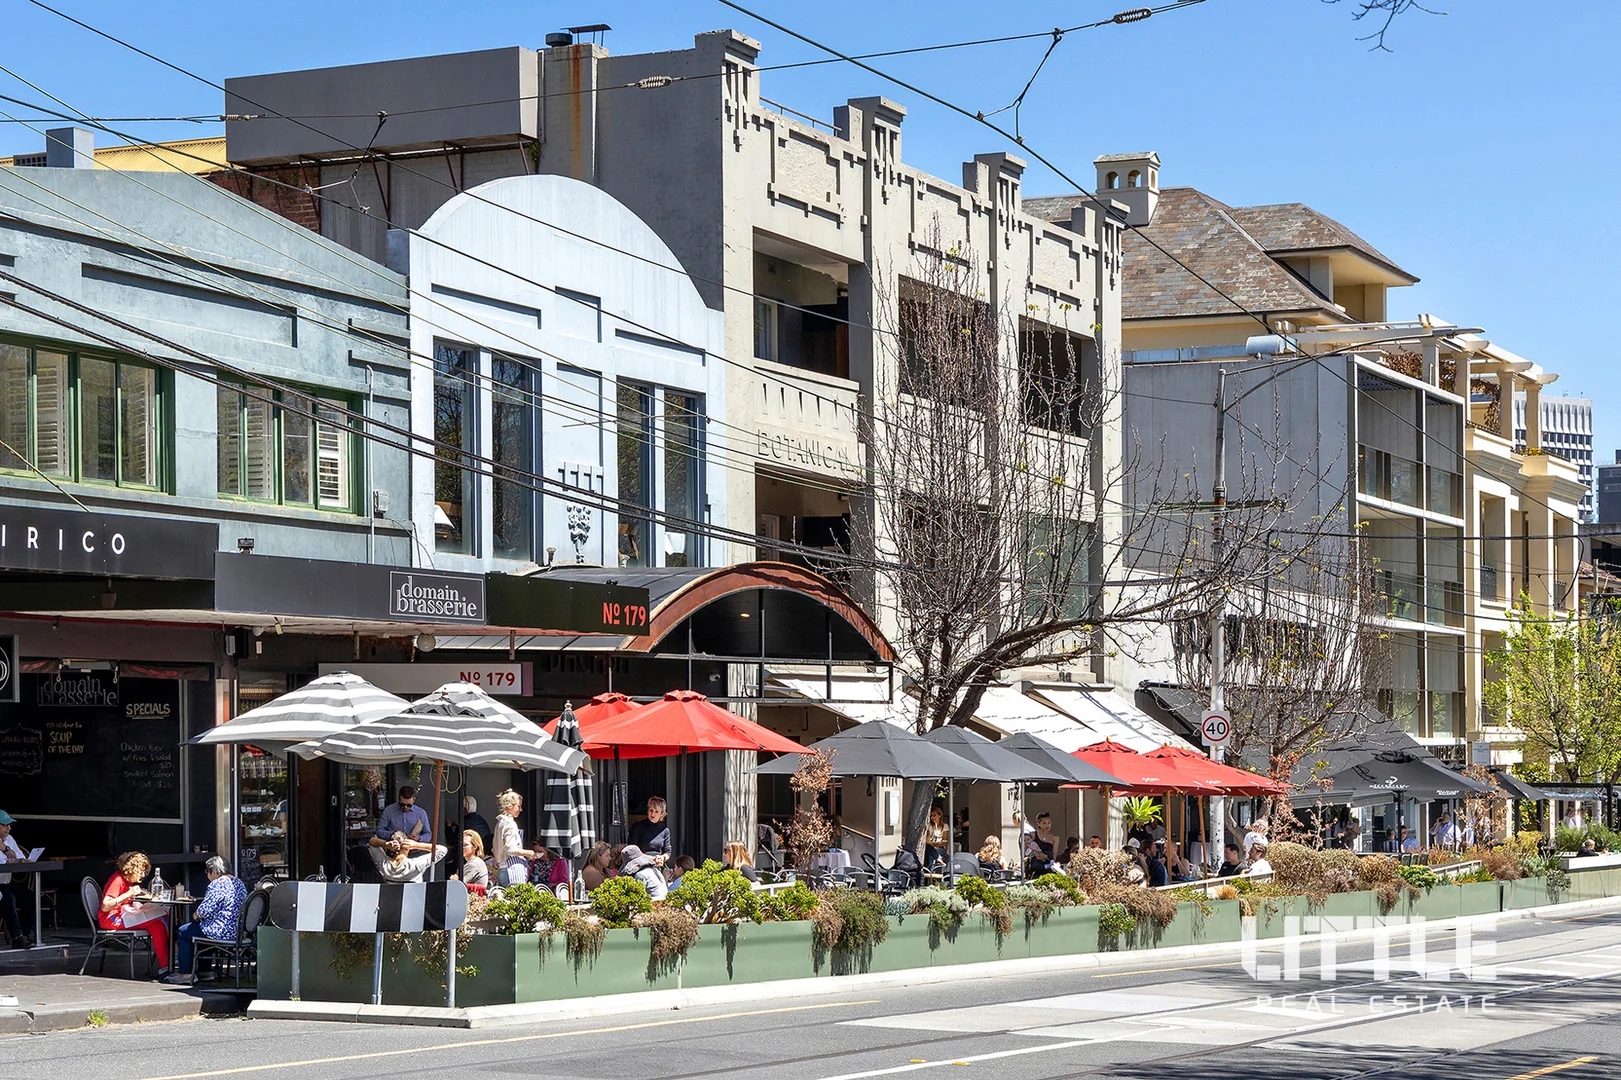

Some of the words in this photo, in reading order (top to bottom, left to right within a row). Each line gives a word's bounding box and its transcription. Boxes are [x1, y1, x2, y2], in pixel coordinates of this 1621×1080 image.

[757, 429, 855, 472] BOTANICAL
[401, 576, 460, 601] domain
[396, 589, 477, 617] brasserie
[624, 605, 646, 627] 179
[43, 676, 101, 694] domain
[486, 672, 515, 687] 179
[126, 703, 170, 716] SPECIALS
[1206, 722, 1226, 735] 40
[50, 731, 73, 744] SOUP
[48, 746, 57, 754] OF
[58, 745, 72, 754] THE
